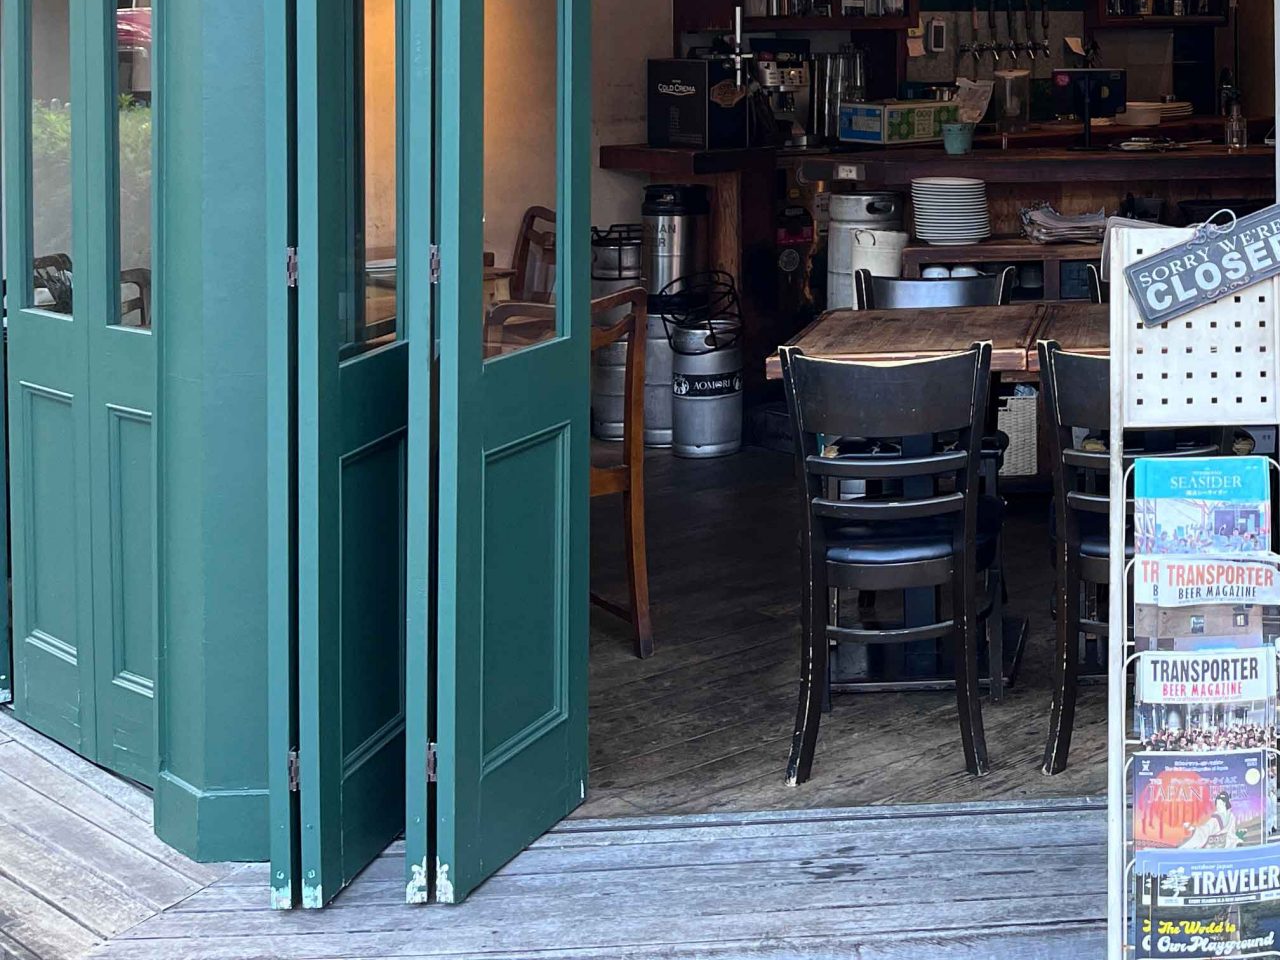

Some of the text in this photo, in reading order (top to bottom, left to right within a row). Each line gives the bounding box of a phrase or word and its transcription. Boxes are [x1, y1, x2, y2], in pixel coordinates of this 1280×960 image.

[1139, 246, 1210, 288] SORRY
[1170, 475, 1242, 489] SEASIDER
[1167, 564, 1274, 587] TRANSPORTER
[1178, 585, 1257, 600] BEER MAGAZINE
[1150, 657, 1258, 682] TRANSPORTER
[1162, 682, 1242, 696] BEER MAGAZINE
[1190, 865, 1280, 895] TRAVELER
[1158, 920, 1180, 934] The
[1180, 920, 1224, 934] World
[1157, 931, 1275, 955] Our Playground
